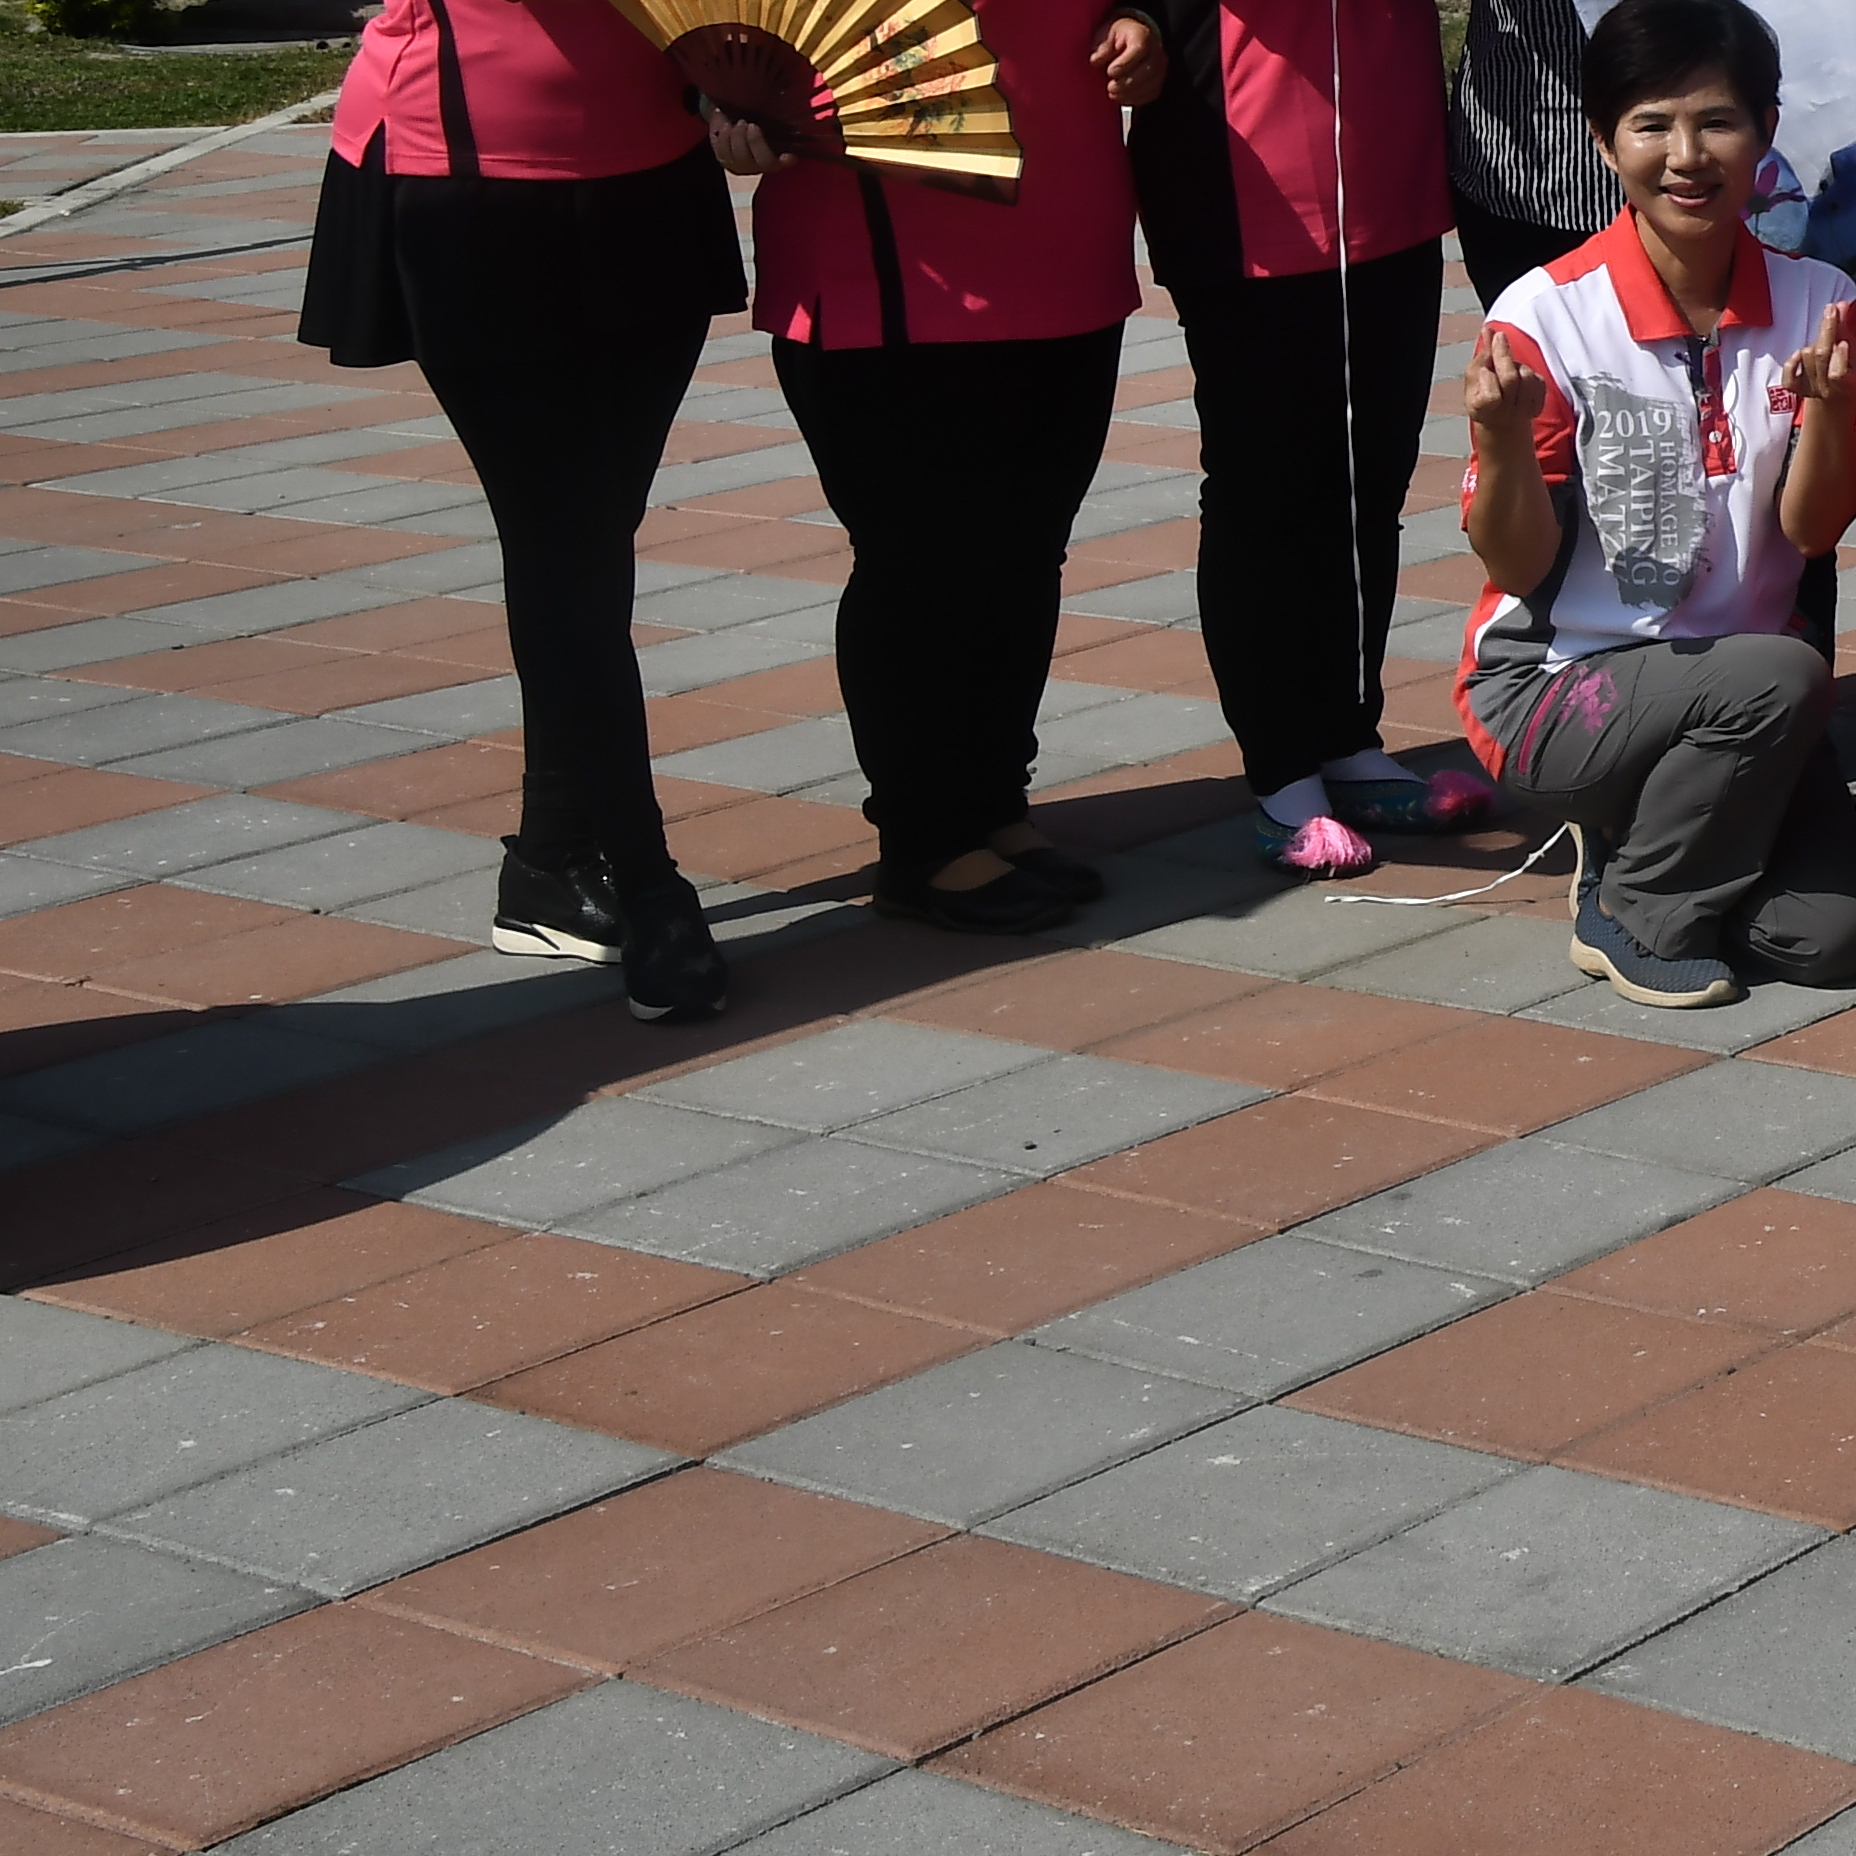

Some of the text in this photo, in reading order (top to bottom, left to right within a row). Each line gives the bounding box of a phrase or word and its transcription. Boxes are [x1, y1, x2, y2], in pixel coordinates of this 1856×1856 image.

[1597, 408, 1672, 440] 2019
[1629, 439, 1658, 586] TAIPING
[1659, 441, 1682, 586] HOMAGE TO
